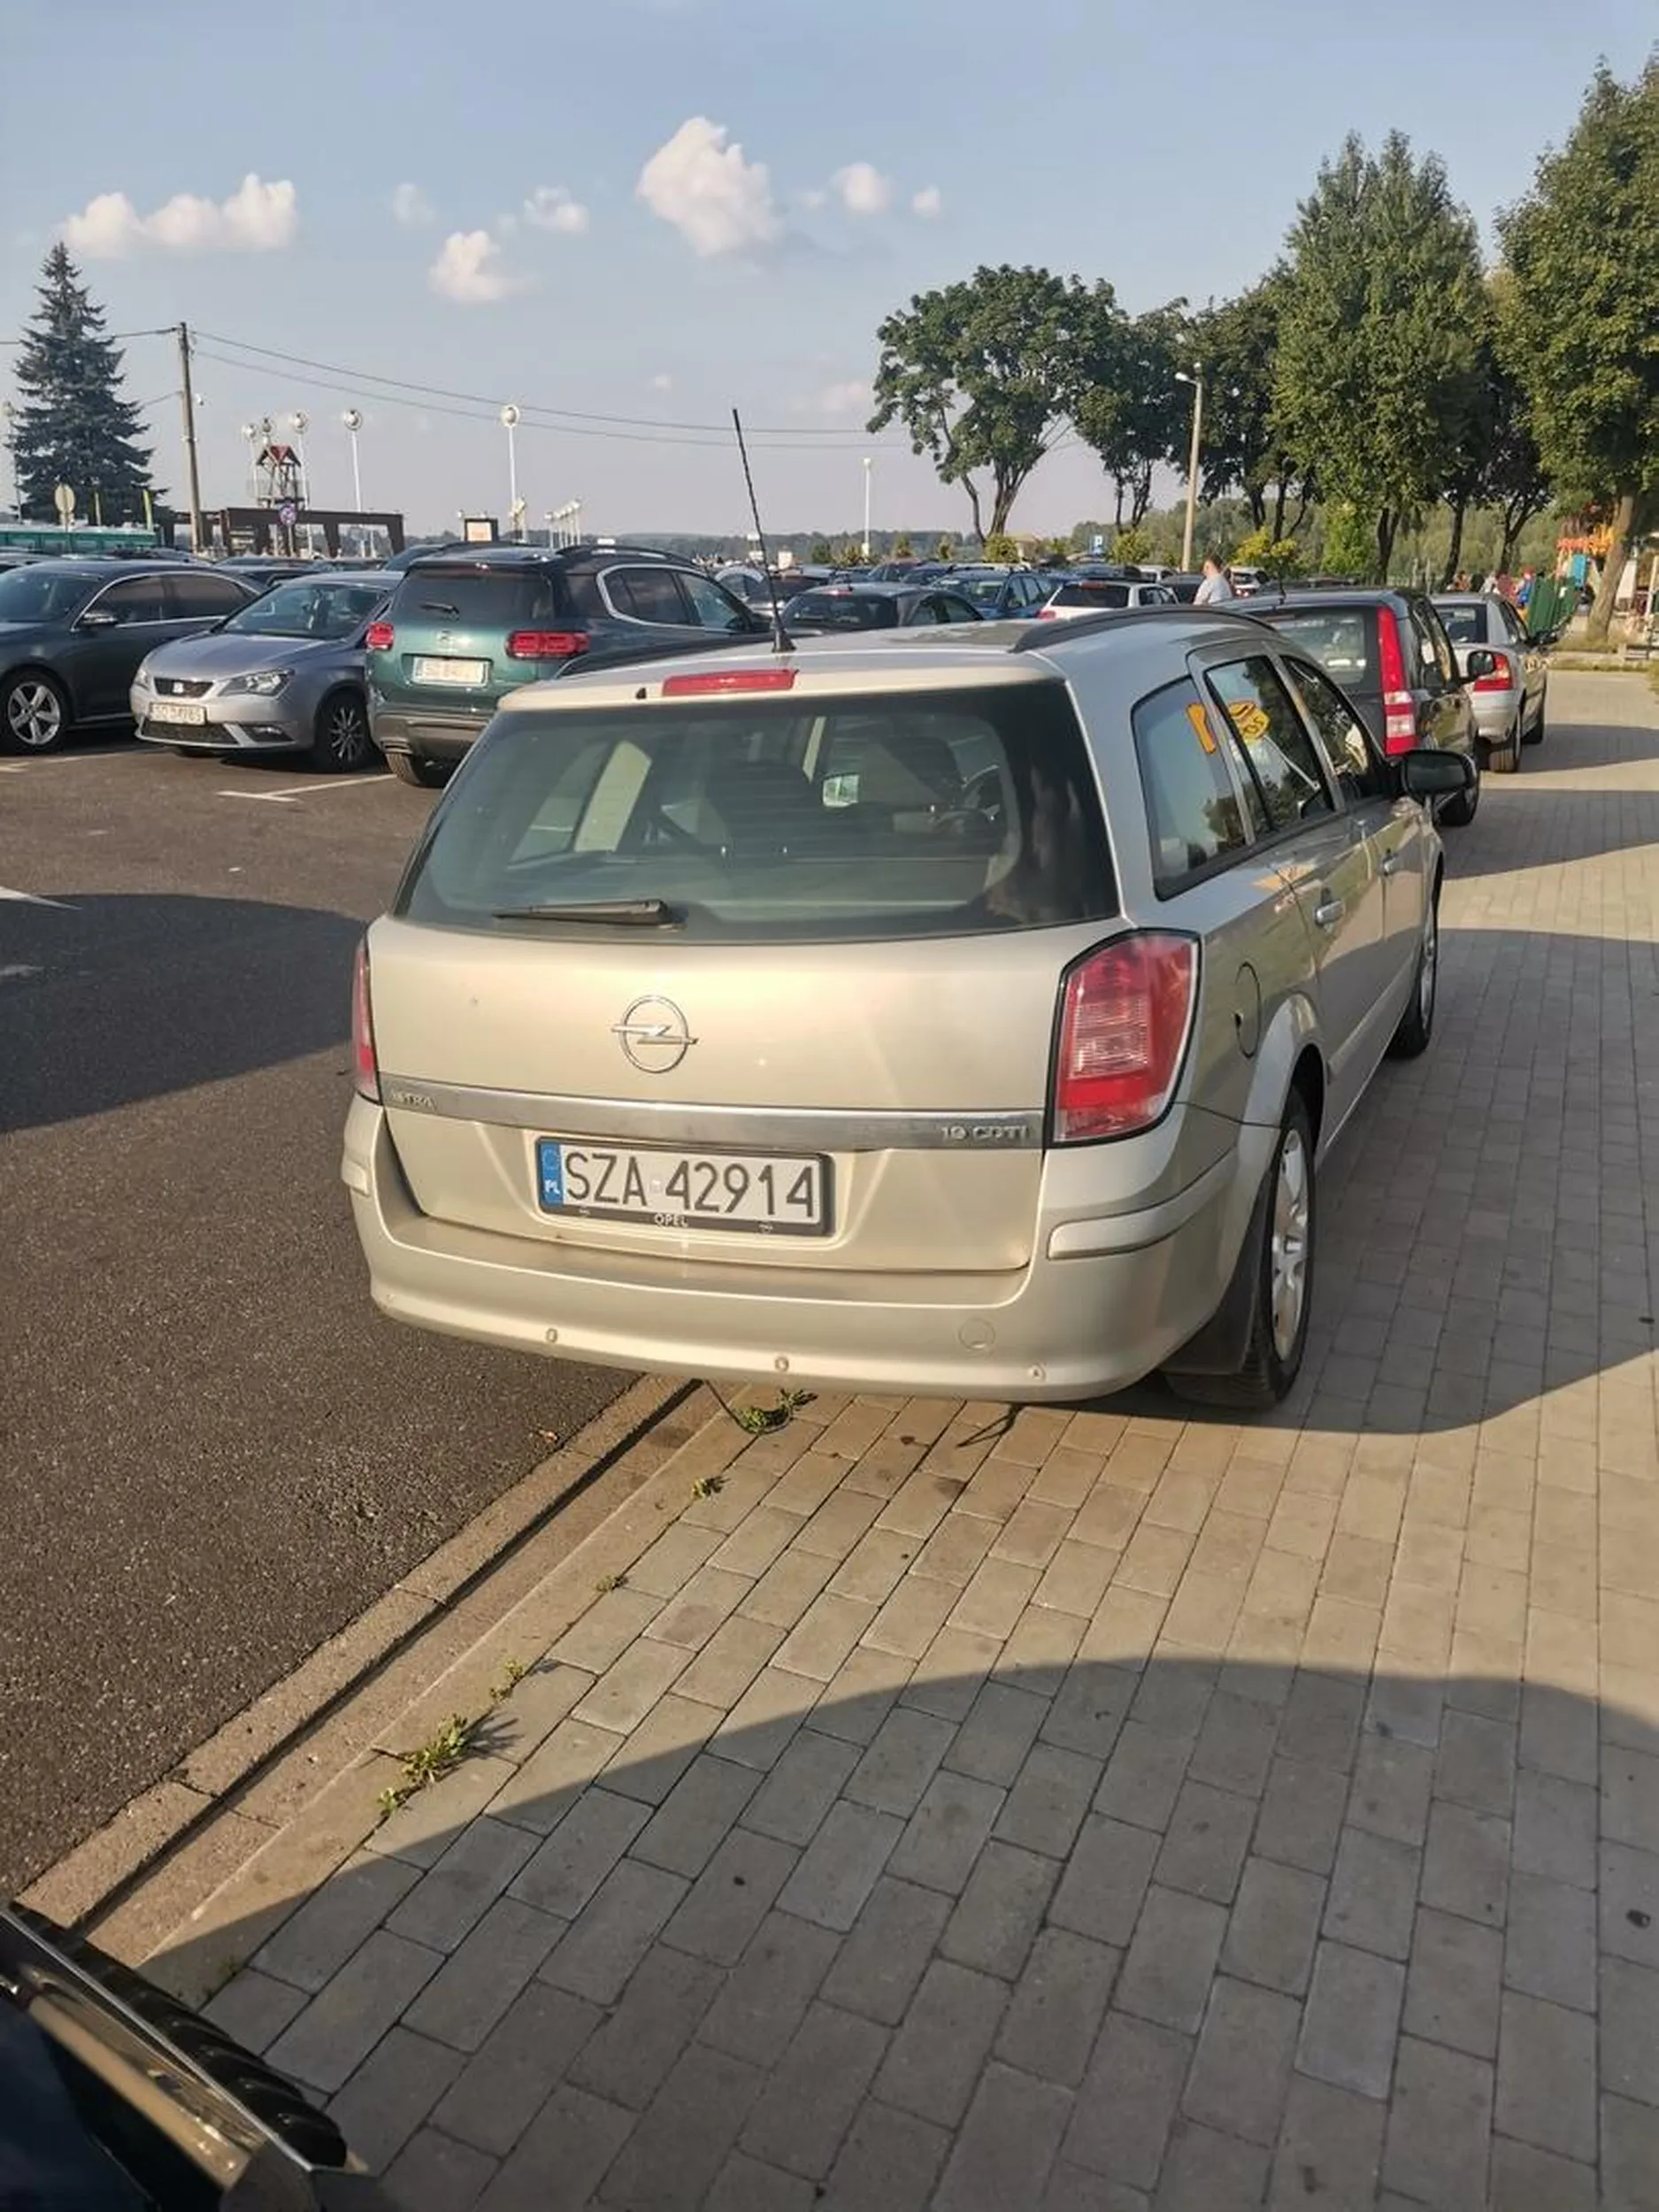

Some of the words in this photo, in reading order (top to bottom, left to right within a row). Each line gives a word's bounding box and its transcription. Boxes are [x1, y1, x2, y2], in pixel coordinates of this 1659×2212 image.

[544, 1179, 561, 1194] PL
[565, 1151, 647, 1207] SZA
[664, 1160, 813, 1217] 42914
[654, 1213, 688, 1228] OPEL
